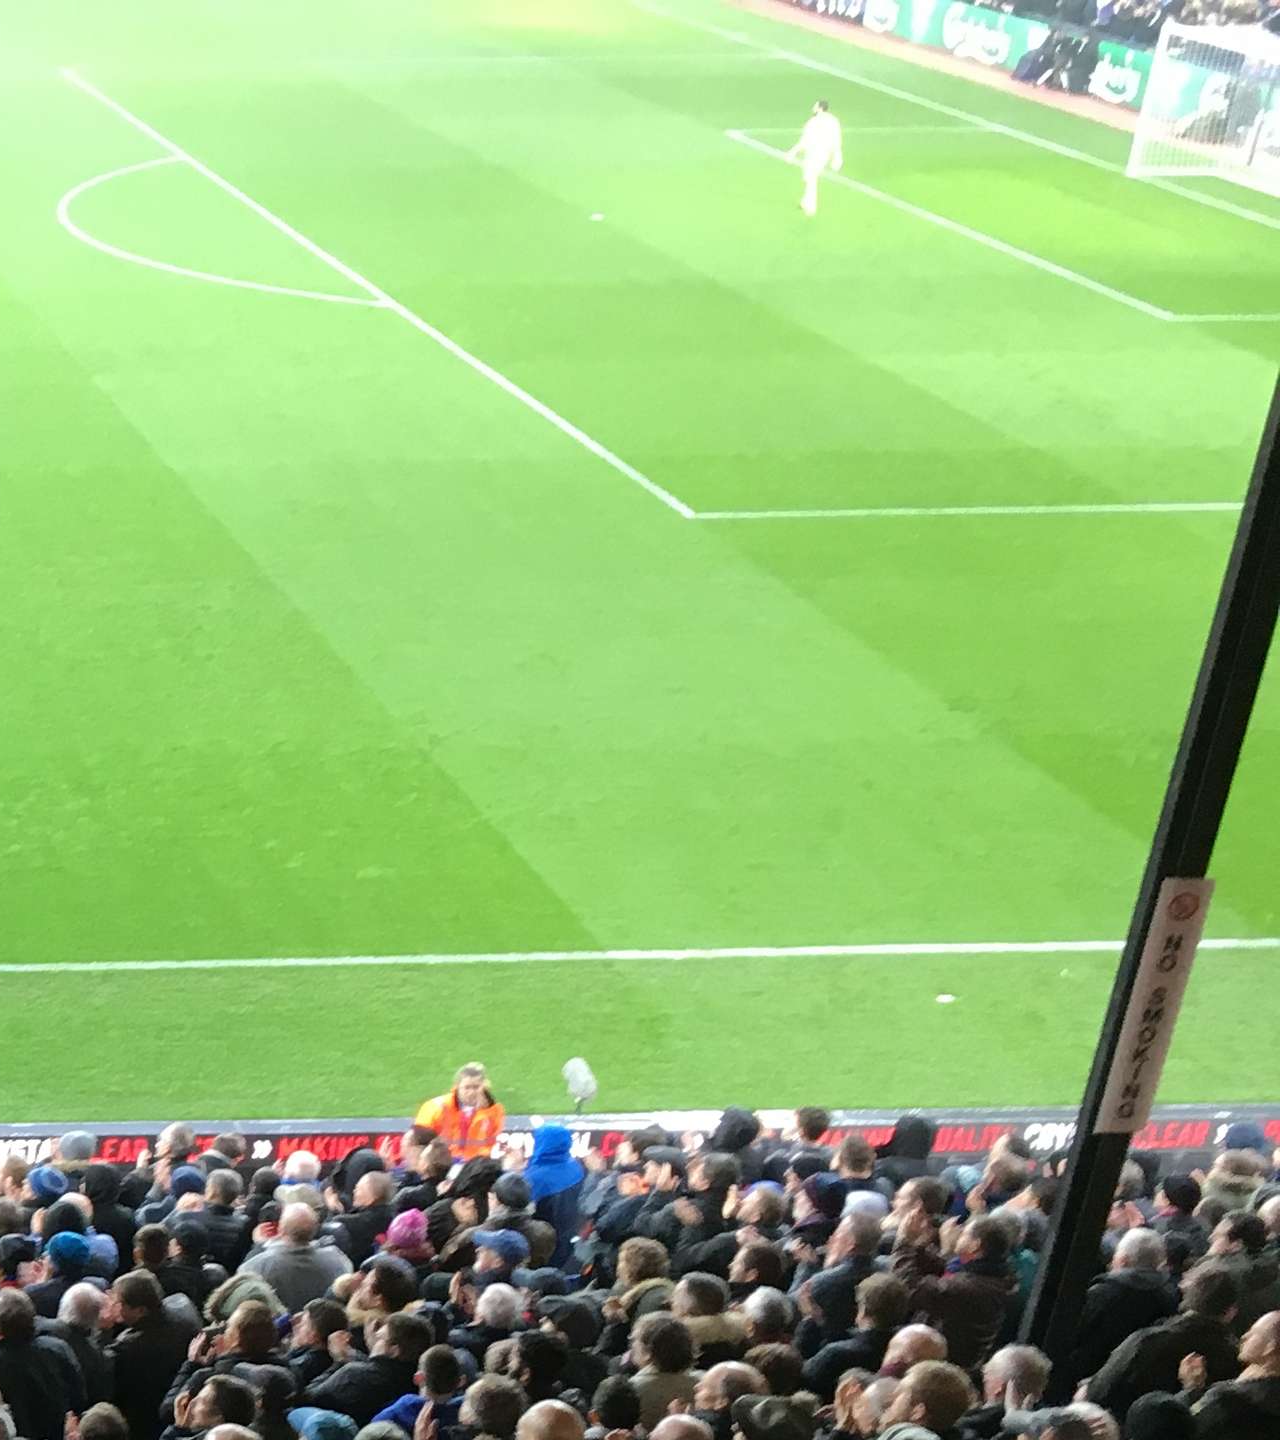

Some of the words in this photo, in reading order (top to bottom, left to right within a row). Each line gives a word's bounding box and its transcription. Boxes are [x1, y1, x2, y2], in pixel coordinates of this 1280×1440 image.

[1155, 934, 1184, 974] NO
[1115, 986, 1168, 1120] SMOKING
[89, 1137, 148, 1164] EAR
